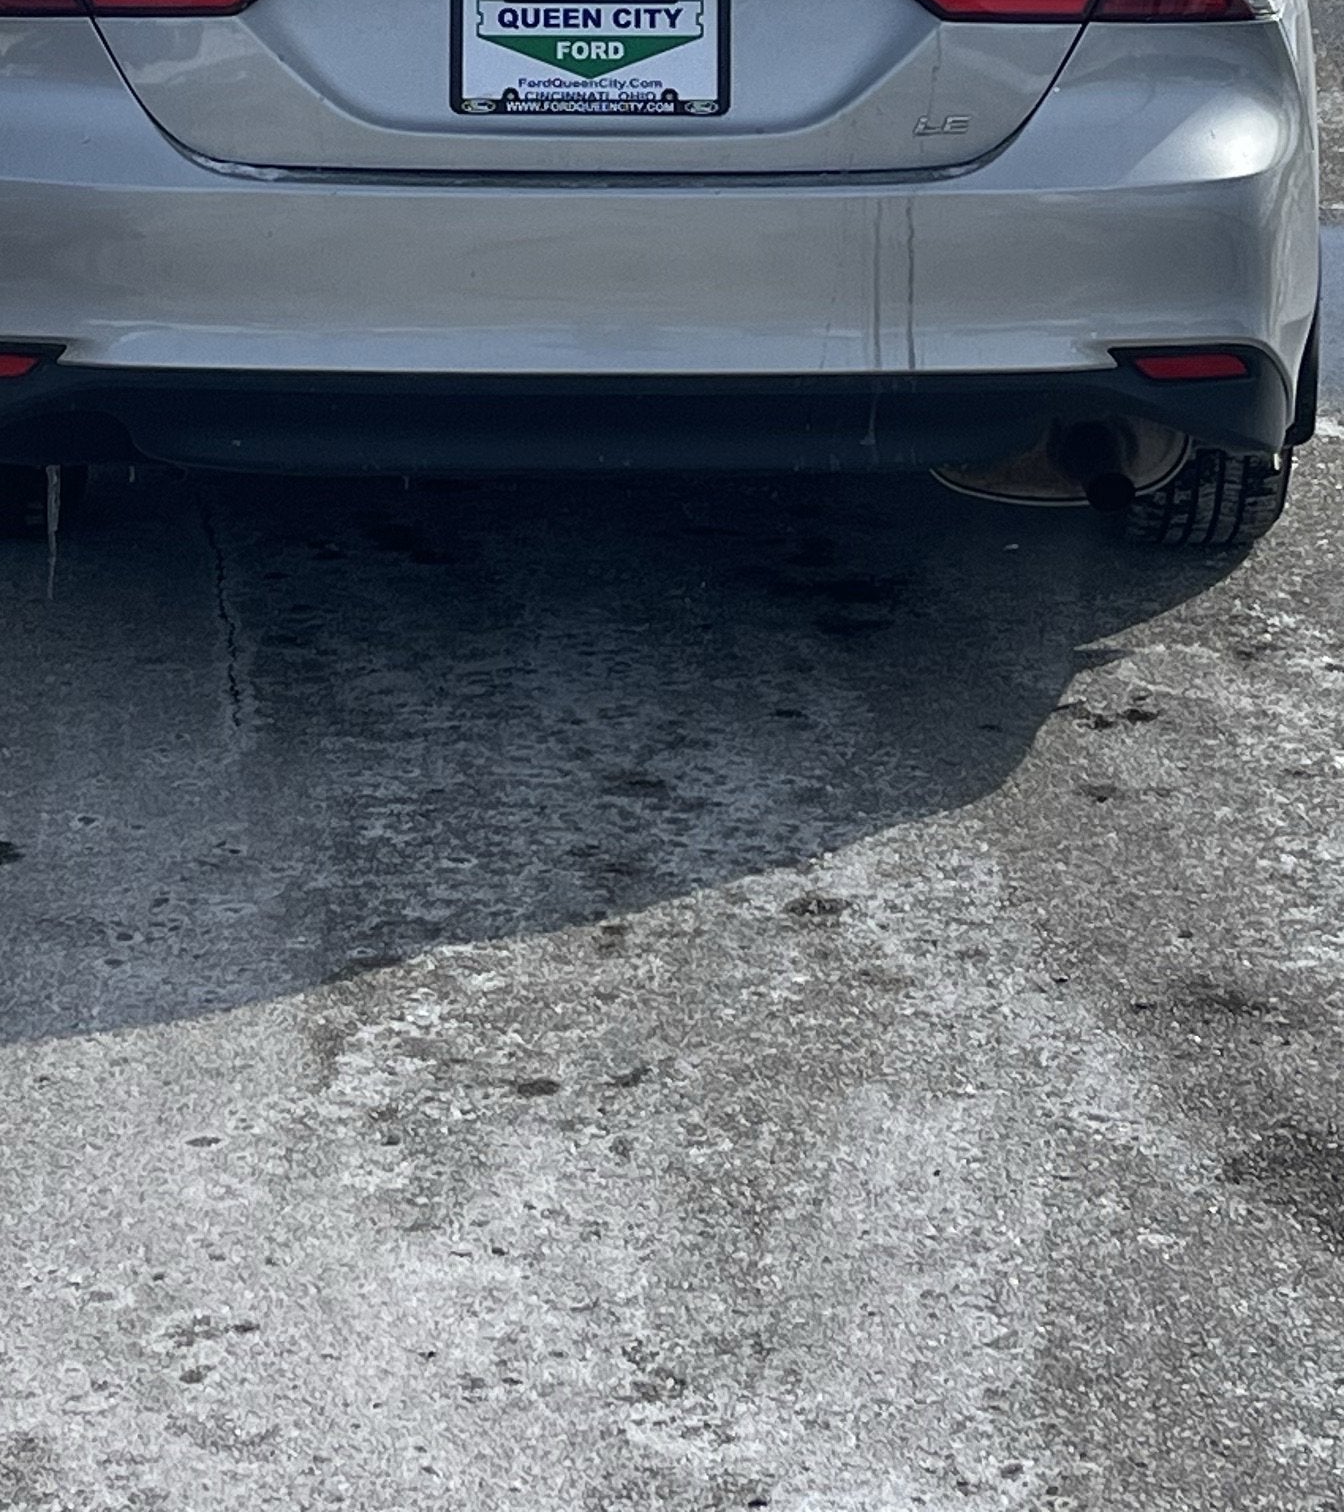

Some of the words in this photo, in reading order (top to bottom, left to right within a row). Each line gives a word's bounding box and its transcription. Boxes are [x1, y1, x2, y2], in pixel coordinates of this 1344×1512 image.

[497, 8, 603, 29] QUEEN
[612, 8, 684, 29] CITY
[556, 40, 625, 60] FORD
[518, 77, 663, 90] FordQueenCity.Com
[618, 91, 656, 101] OHIO
[506, 101, 675, 112] WWW.FORDQUEENCITY.COM
[912, 115, 972, 137] LE
